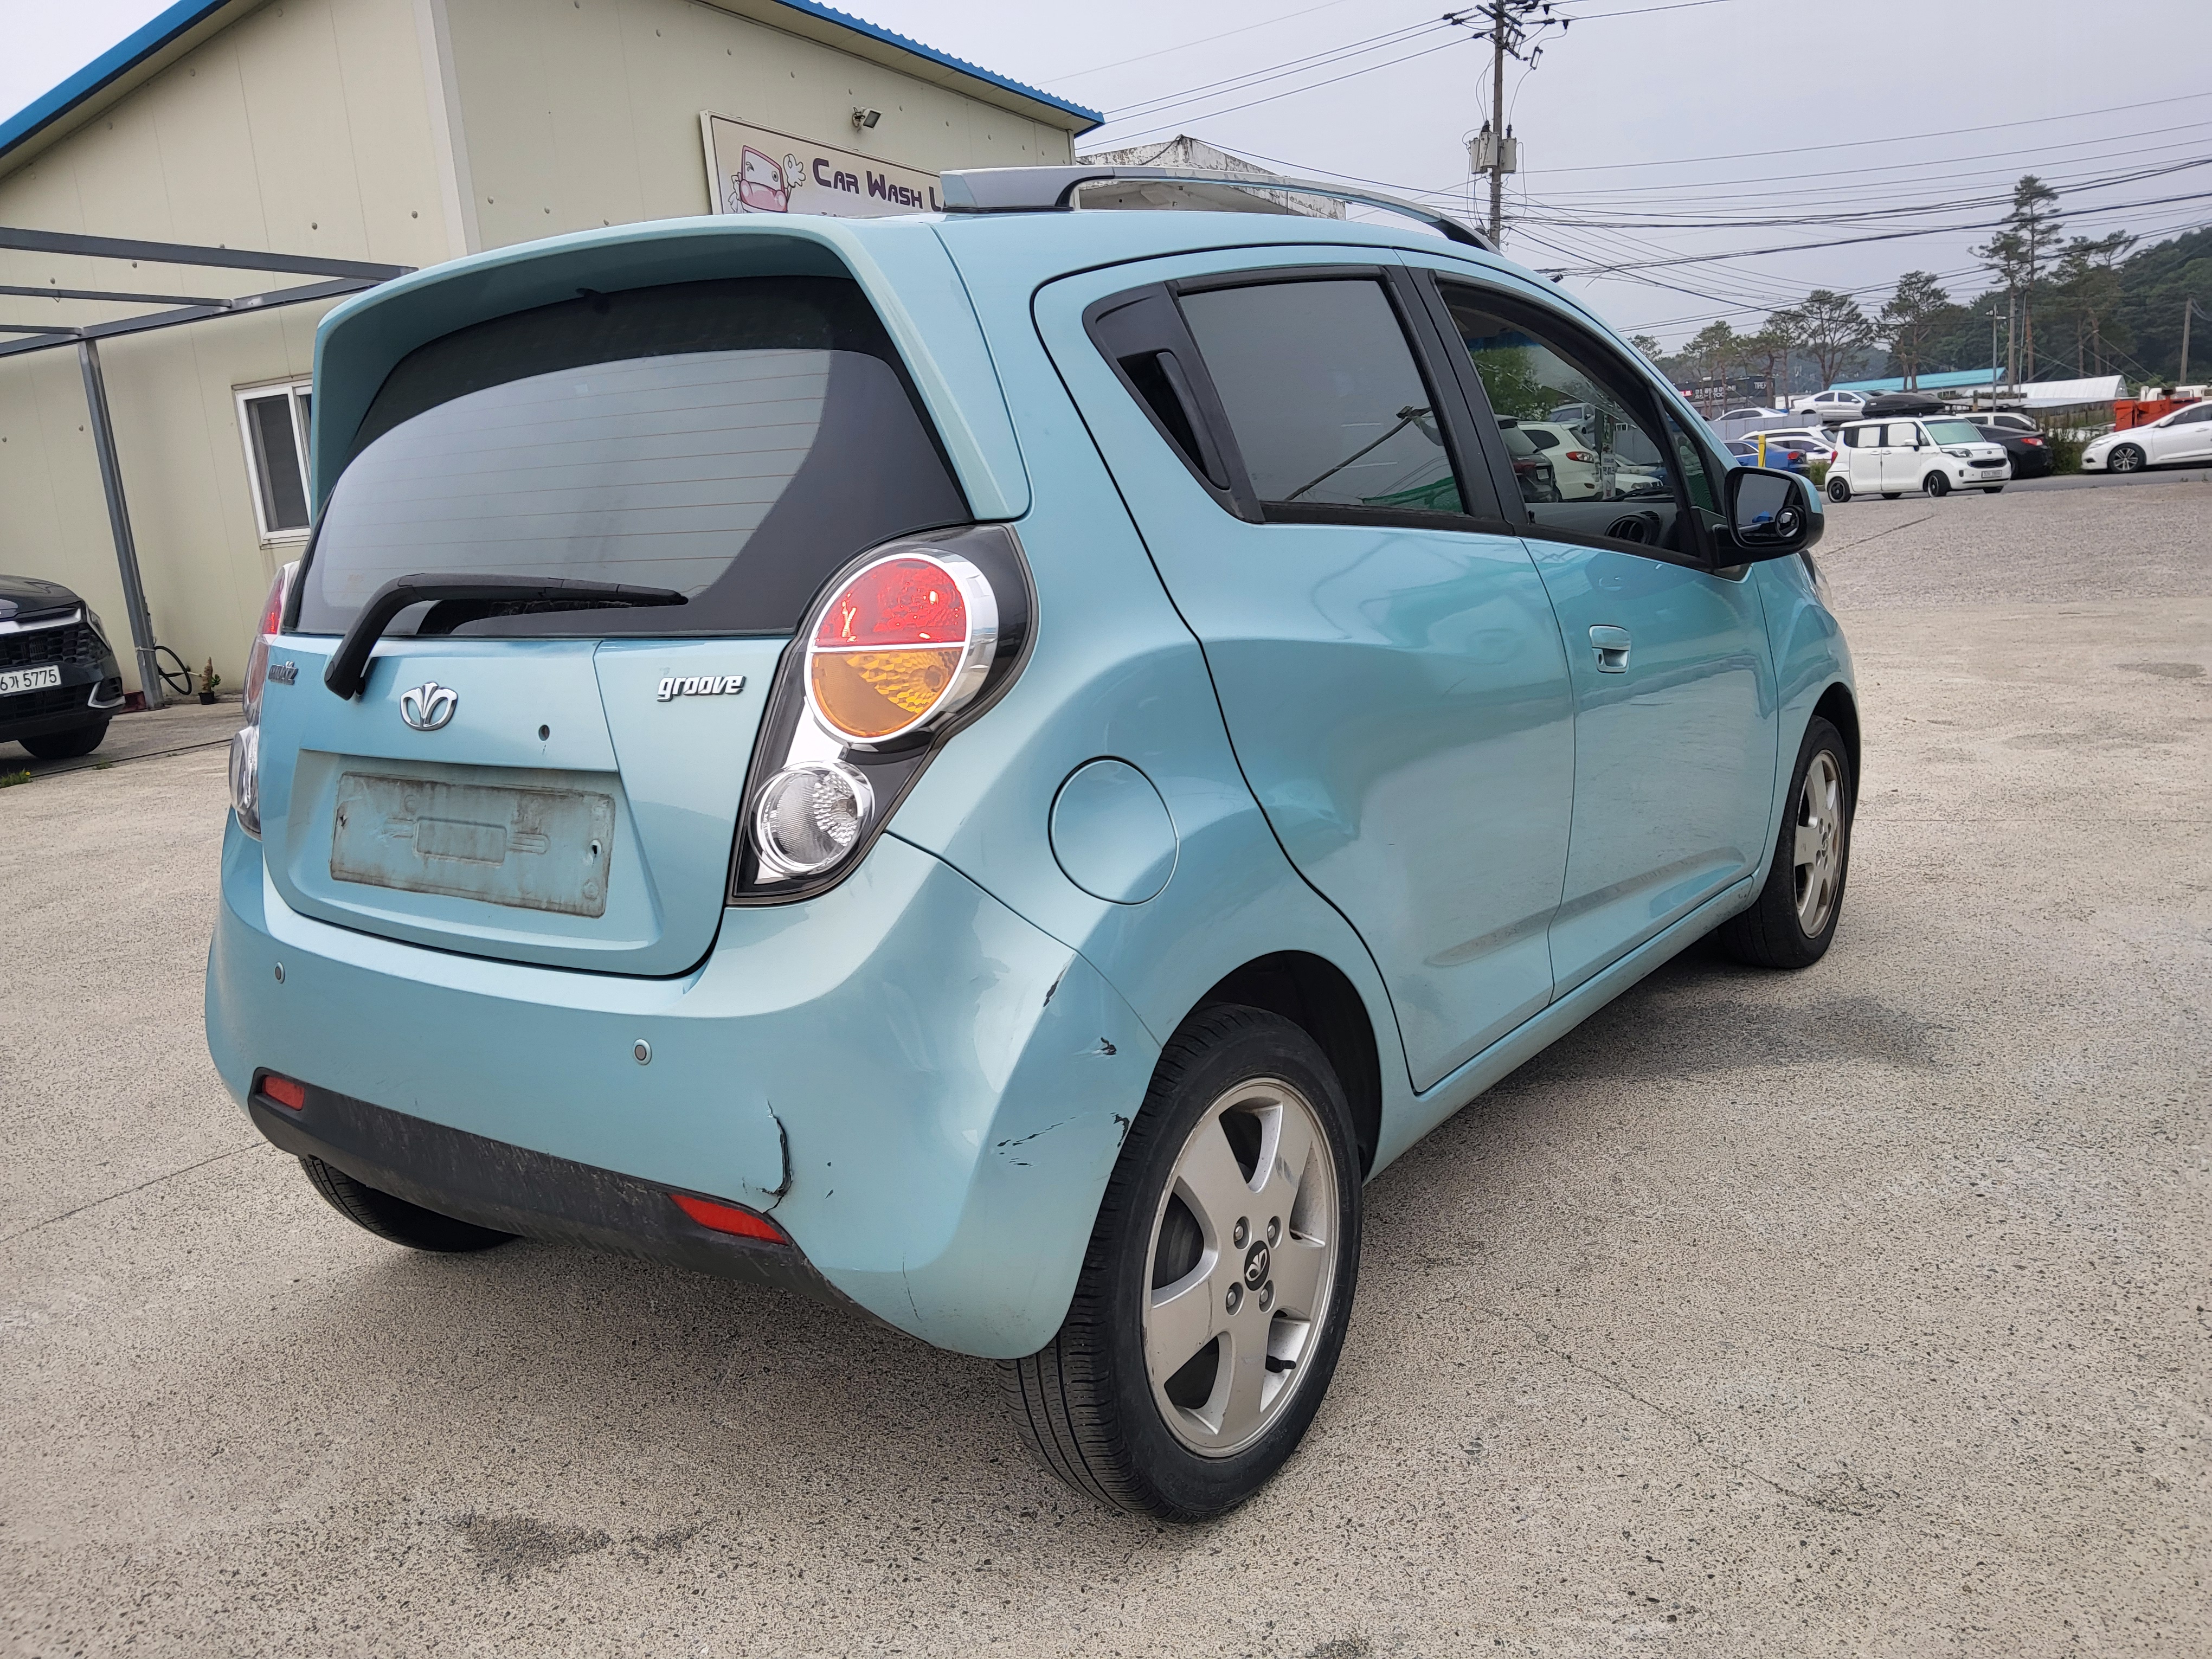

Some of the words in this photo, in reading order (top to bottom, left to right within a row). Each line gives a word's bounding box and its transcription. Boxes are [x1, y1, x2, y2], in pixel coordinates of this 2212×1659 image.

[812, 157, 860, 195] CAR
[866, 170, 923, 210] WASH
[22, 668, 57, 687] 5775
[656, 675, 746, 703] groove
